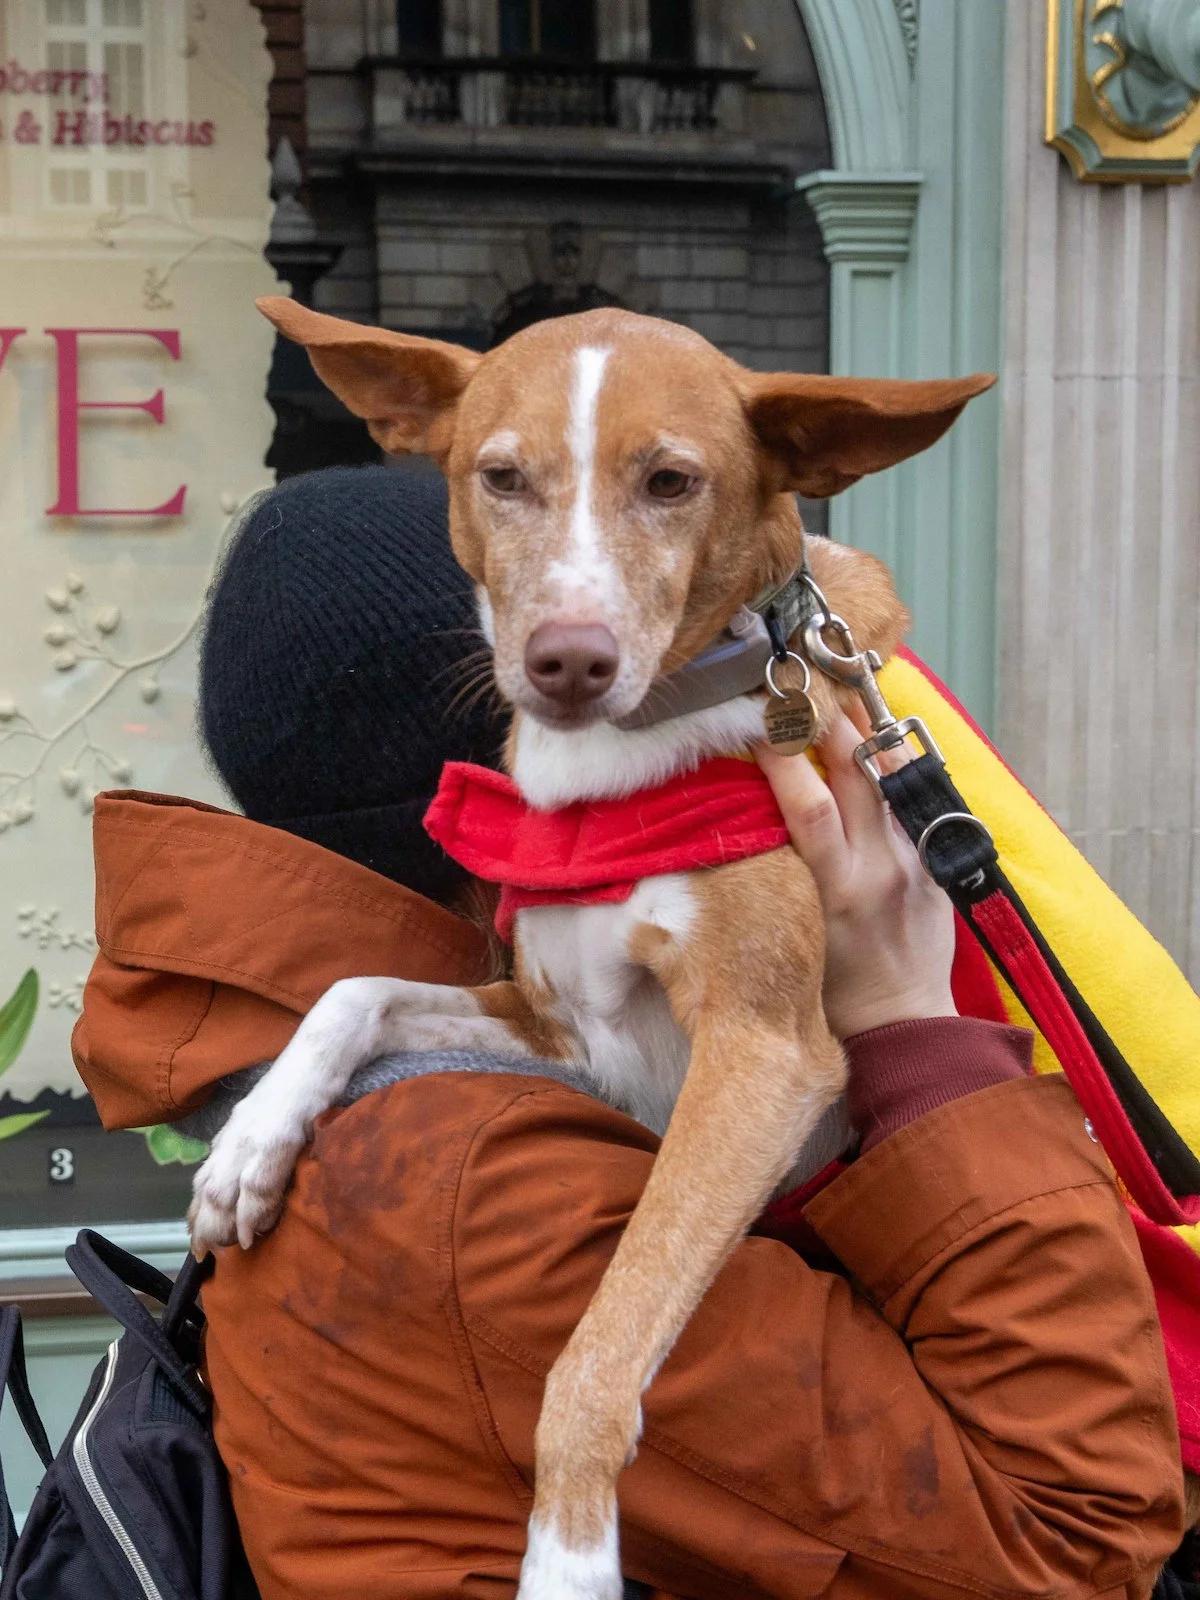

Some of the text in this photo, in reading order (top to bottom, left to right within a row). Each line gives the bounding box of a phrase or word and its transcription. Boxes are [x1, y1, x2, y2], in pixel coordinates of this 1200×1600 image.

[13, 110, 43, 144] &
[53, 110, 216, 146] Hibiscus
[50, 1148, 74, 1180] 3
